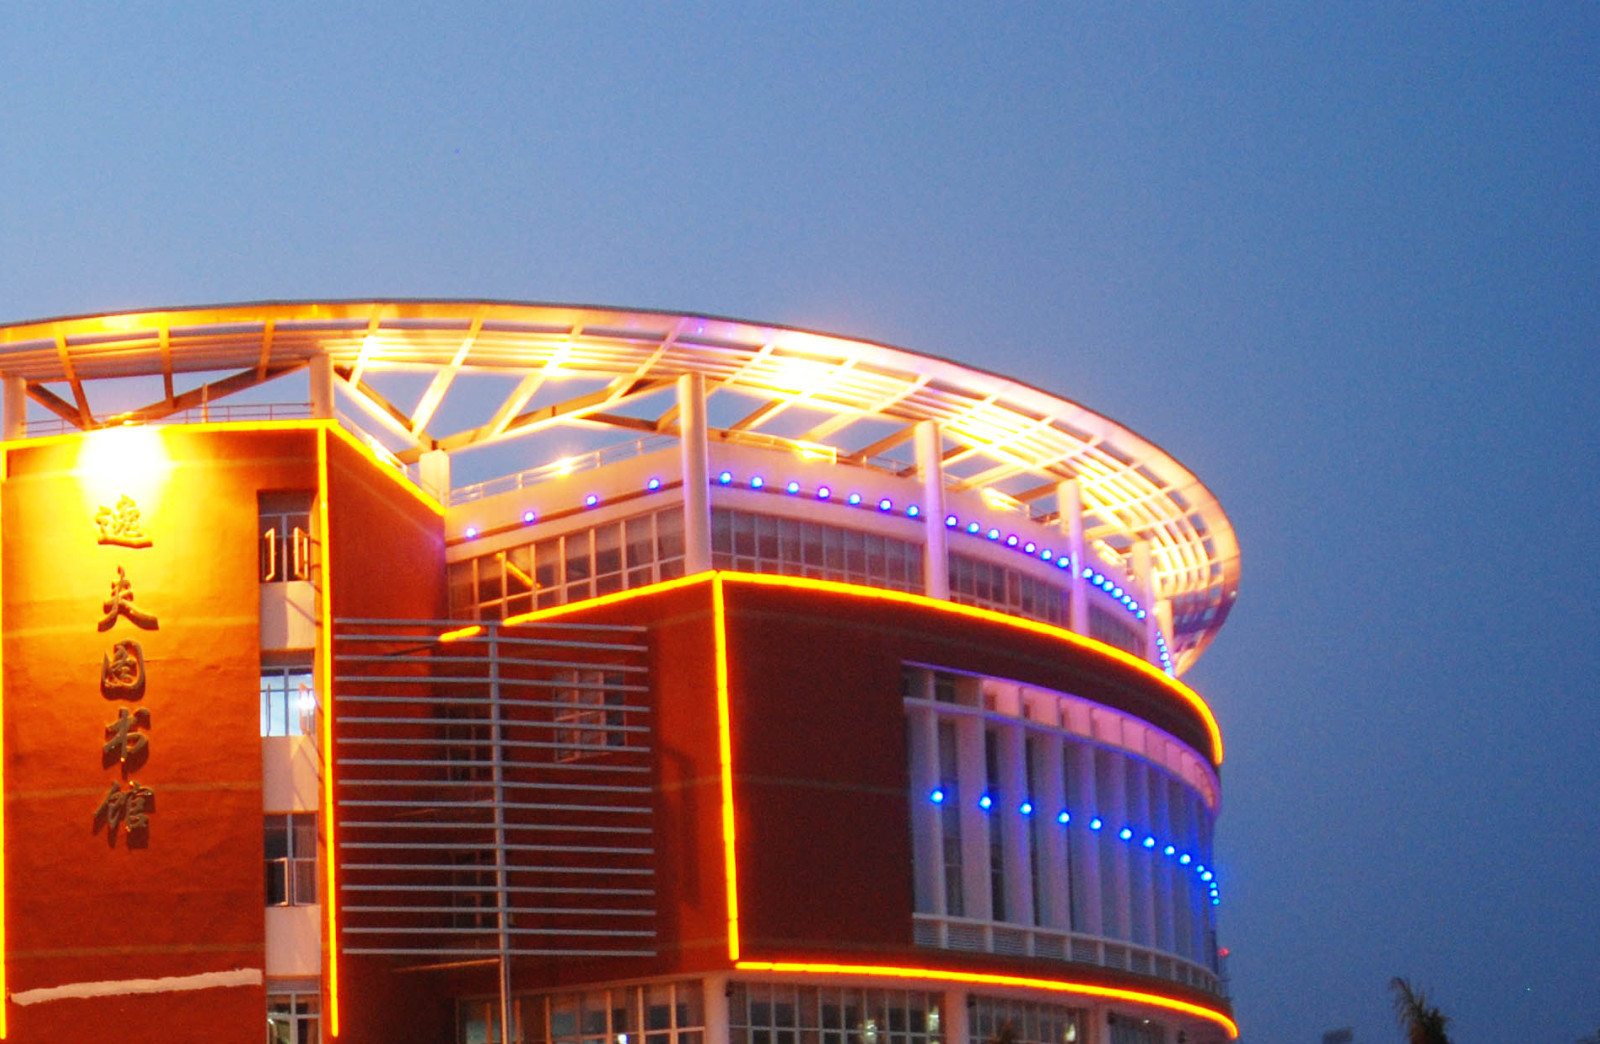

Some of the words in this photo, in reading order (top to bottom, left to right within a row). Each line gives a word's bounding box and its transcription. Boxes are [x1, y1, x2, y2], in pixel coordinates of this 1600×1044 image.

[93, 493, 159, 834] 逸夫图书馆
